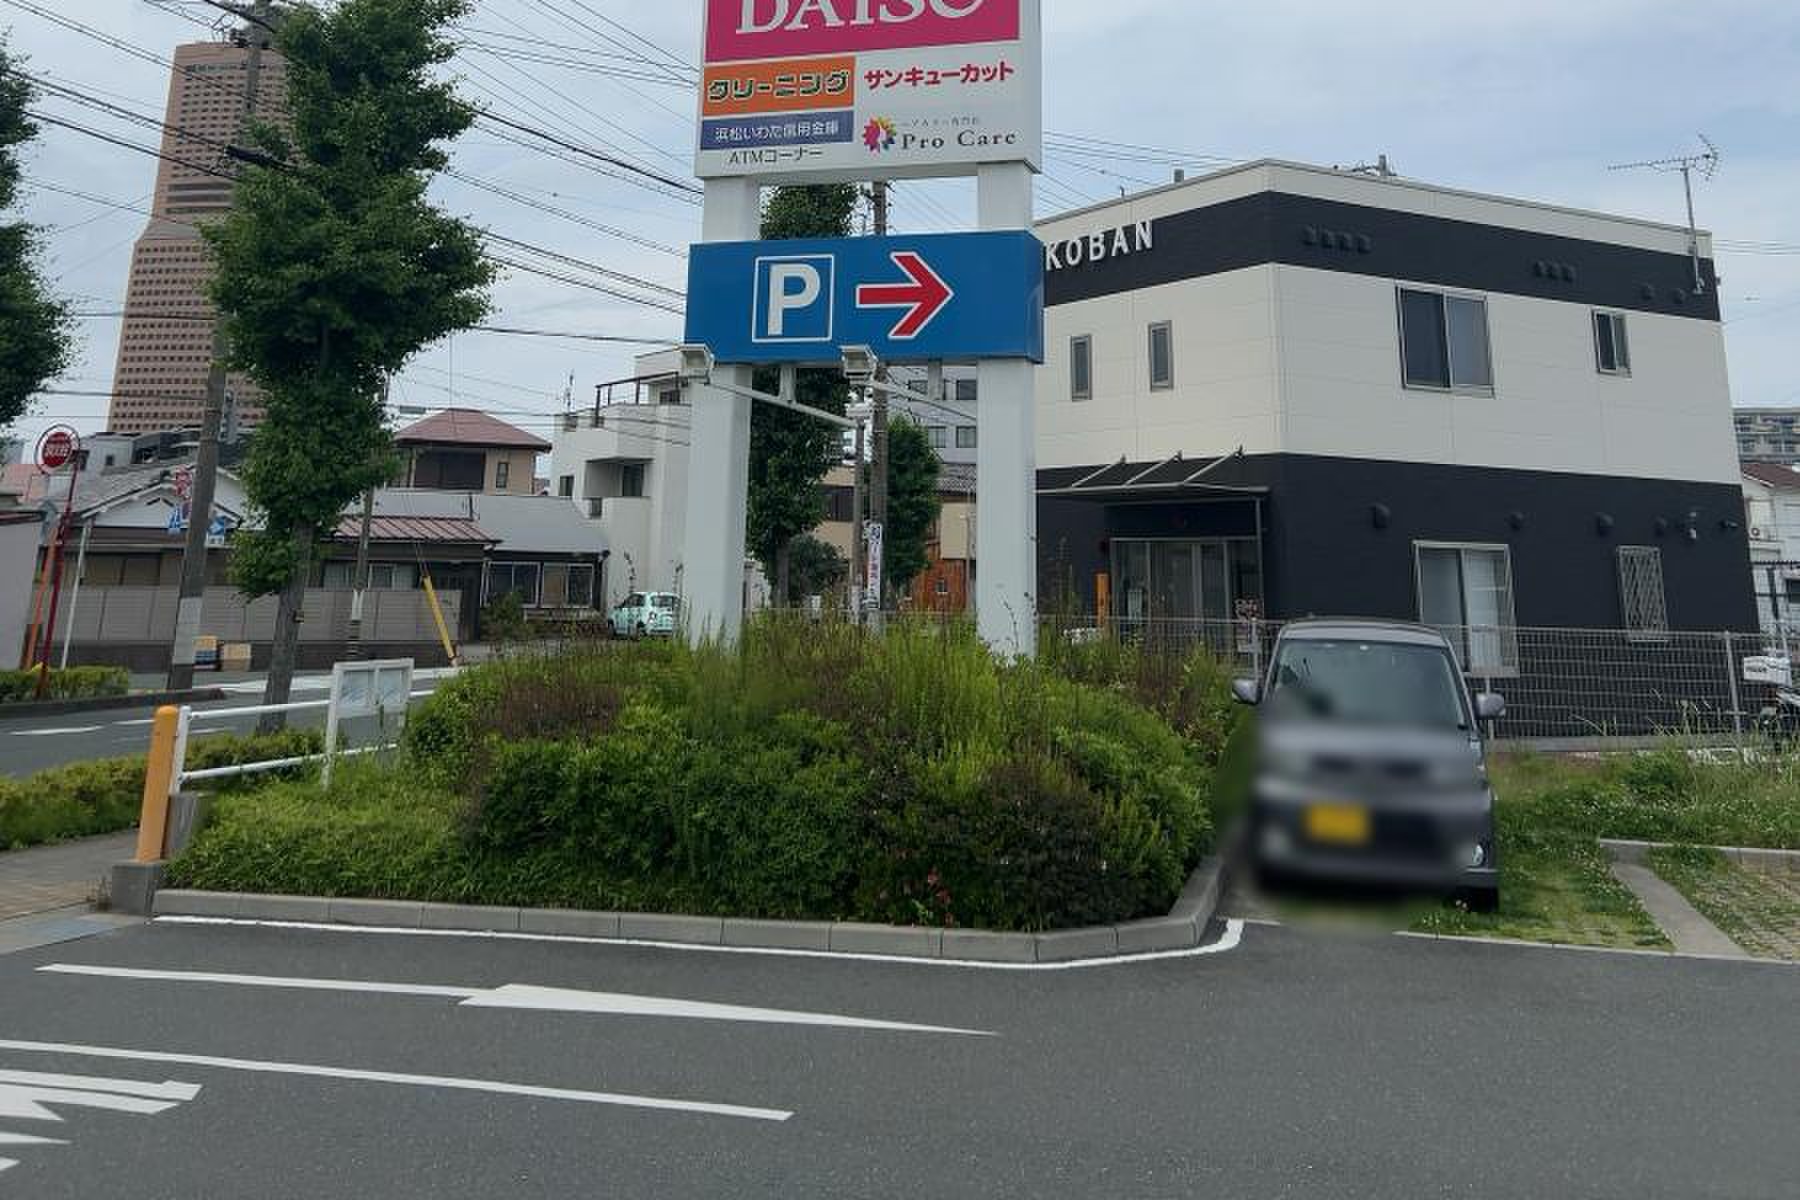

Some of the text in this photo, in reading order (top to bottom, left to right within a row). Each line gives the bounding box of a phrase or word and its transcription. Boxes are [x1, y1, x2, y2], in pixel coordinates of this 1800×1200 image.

[708, 70, 850, 101] クリーニング
[863, 61, 1014, 90] サンキューカット
[902, 129, 1017, 150] Pro Care
[729, 147, 823, 164] ATMコーナー
[1045, 219, 1152, 271] KOBAN
[767, 262, 821, 337] P
